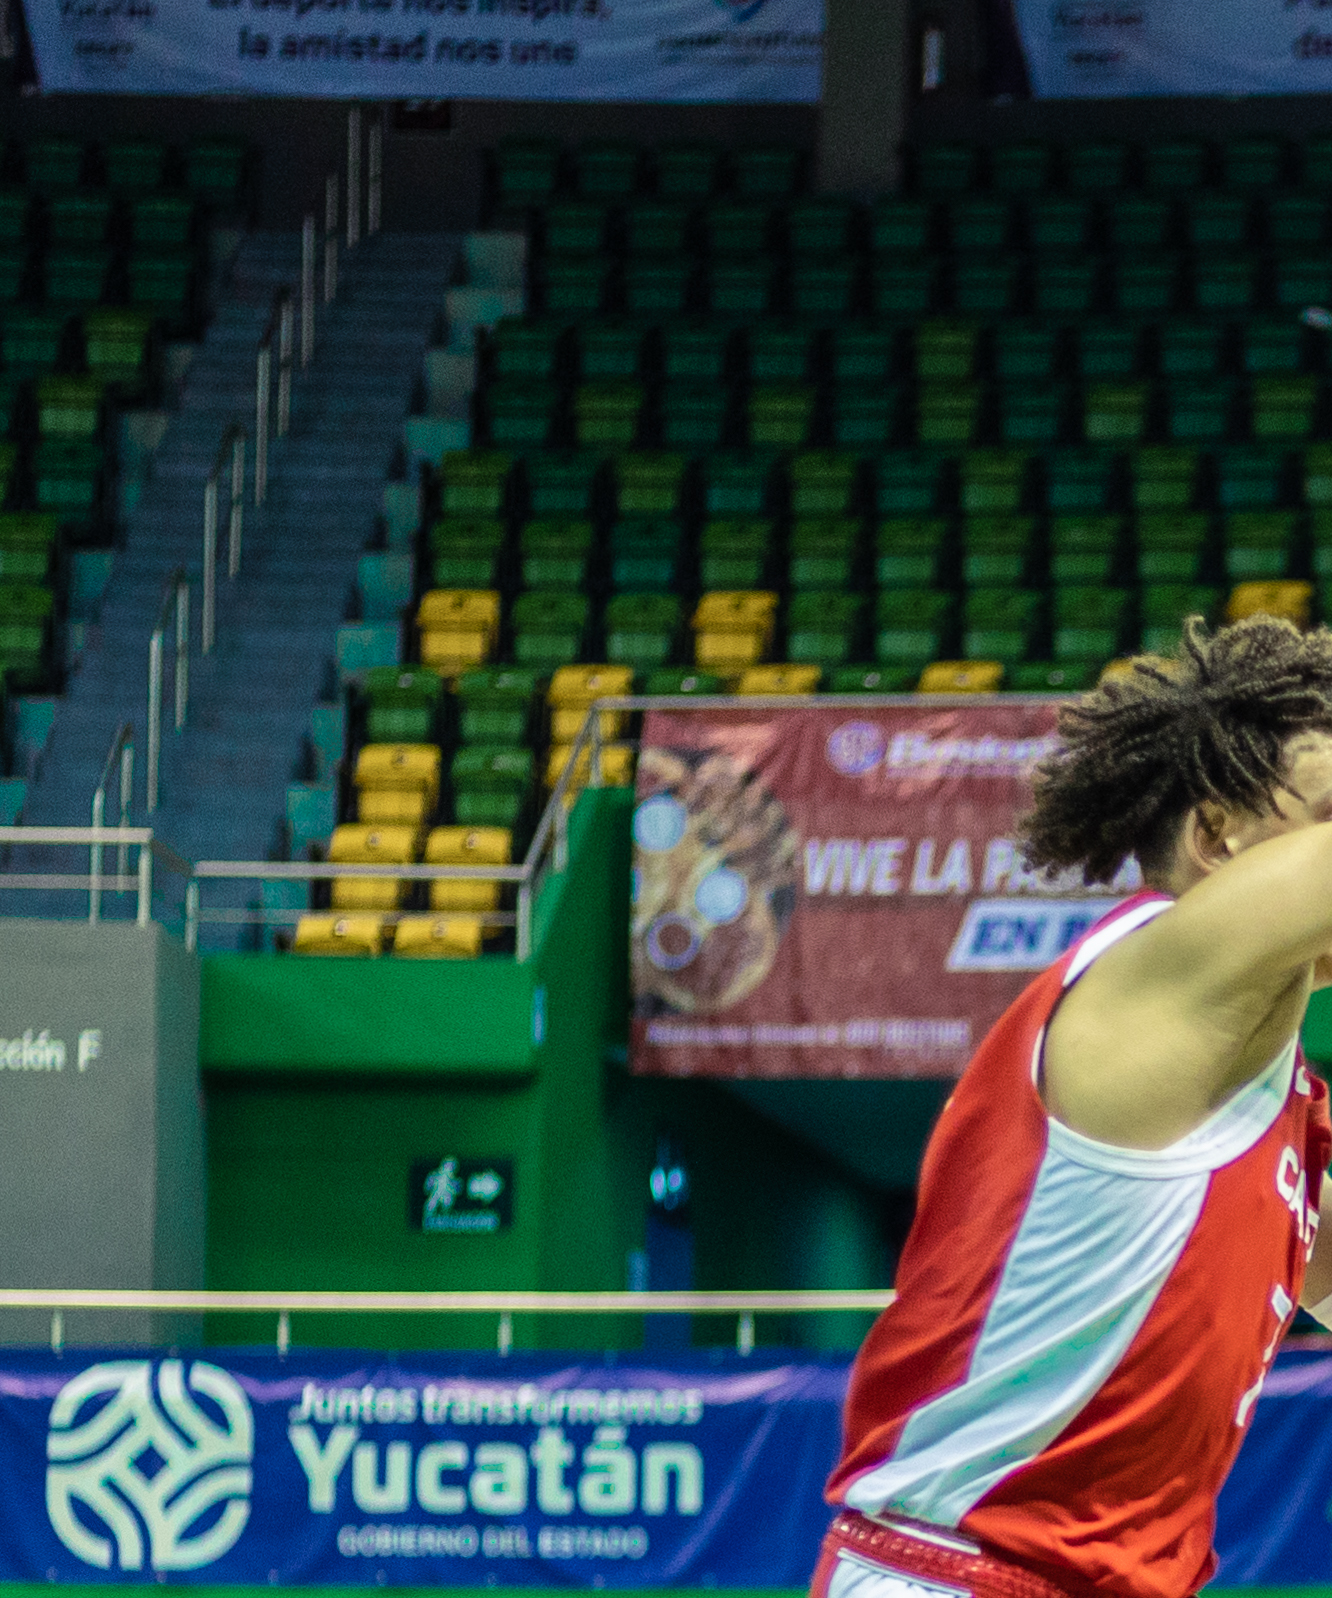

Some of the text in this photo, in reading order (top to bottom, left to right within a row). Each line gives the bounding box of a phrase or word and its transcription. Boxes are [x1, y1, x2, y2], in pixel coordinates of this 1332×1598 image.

[279, 26, 428, 61] amistad
[434, 35, 503, 63] nos
[511, 39, 578, 65] une
[805, 838, 907, 896] VIVE
[910, 838, 974, 896] LA
[78, 1028, 102, 1072] F
[288, 1383, 704, 1426] Juntos transformamos
[287, 1422, 704, 1516] Yucatán
